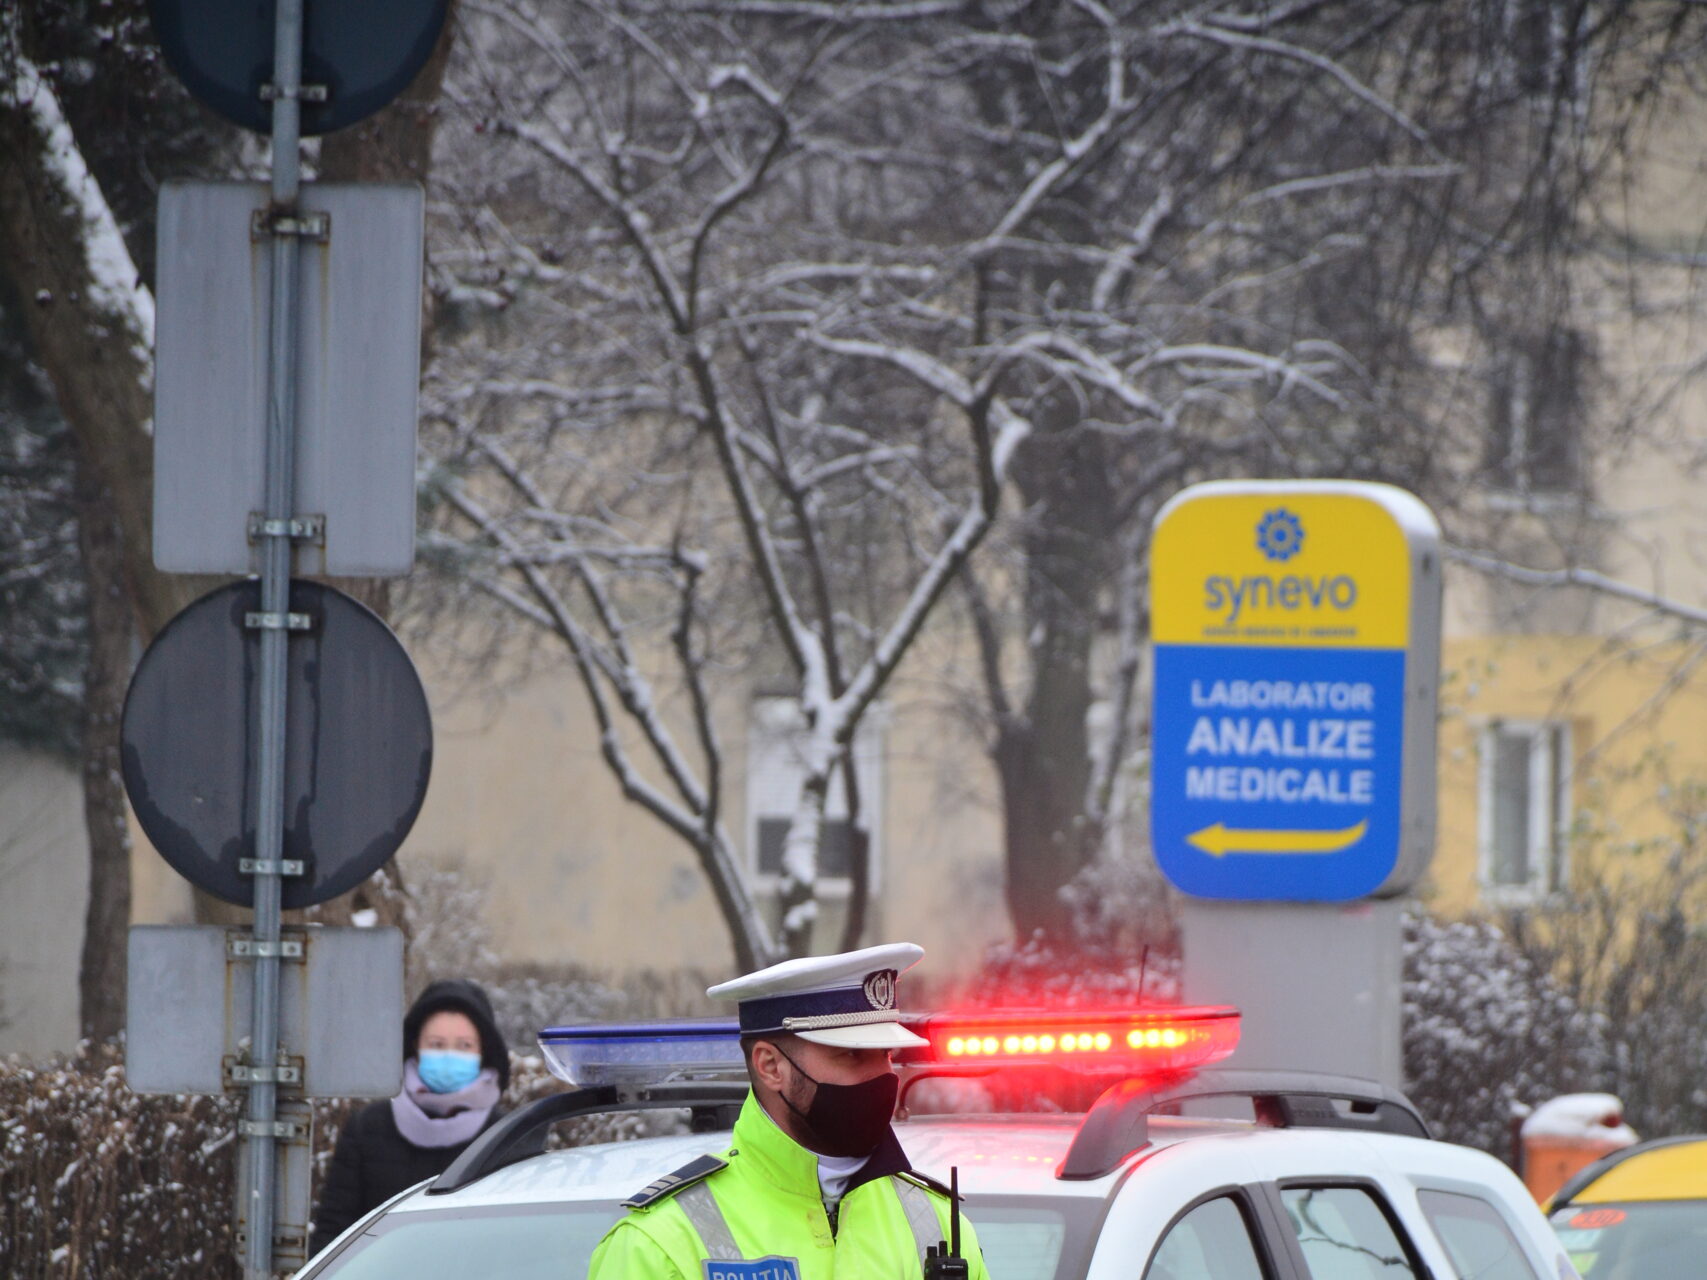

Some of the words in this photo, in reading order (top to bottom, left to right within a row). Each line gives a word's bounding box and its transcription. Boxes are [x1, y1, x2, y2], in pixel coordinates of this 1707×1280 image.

[1204, 574, 1358, 623] synevo
[1191, 681, 1373, 710] LABORATOR
[1186, 717, 1375, 759] ANALIZE
[1186, 767, 1374, 803] MEDICALE
